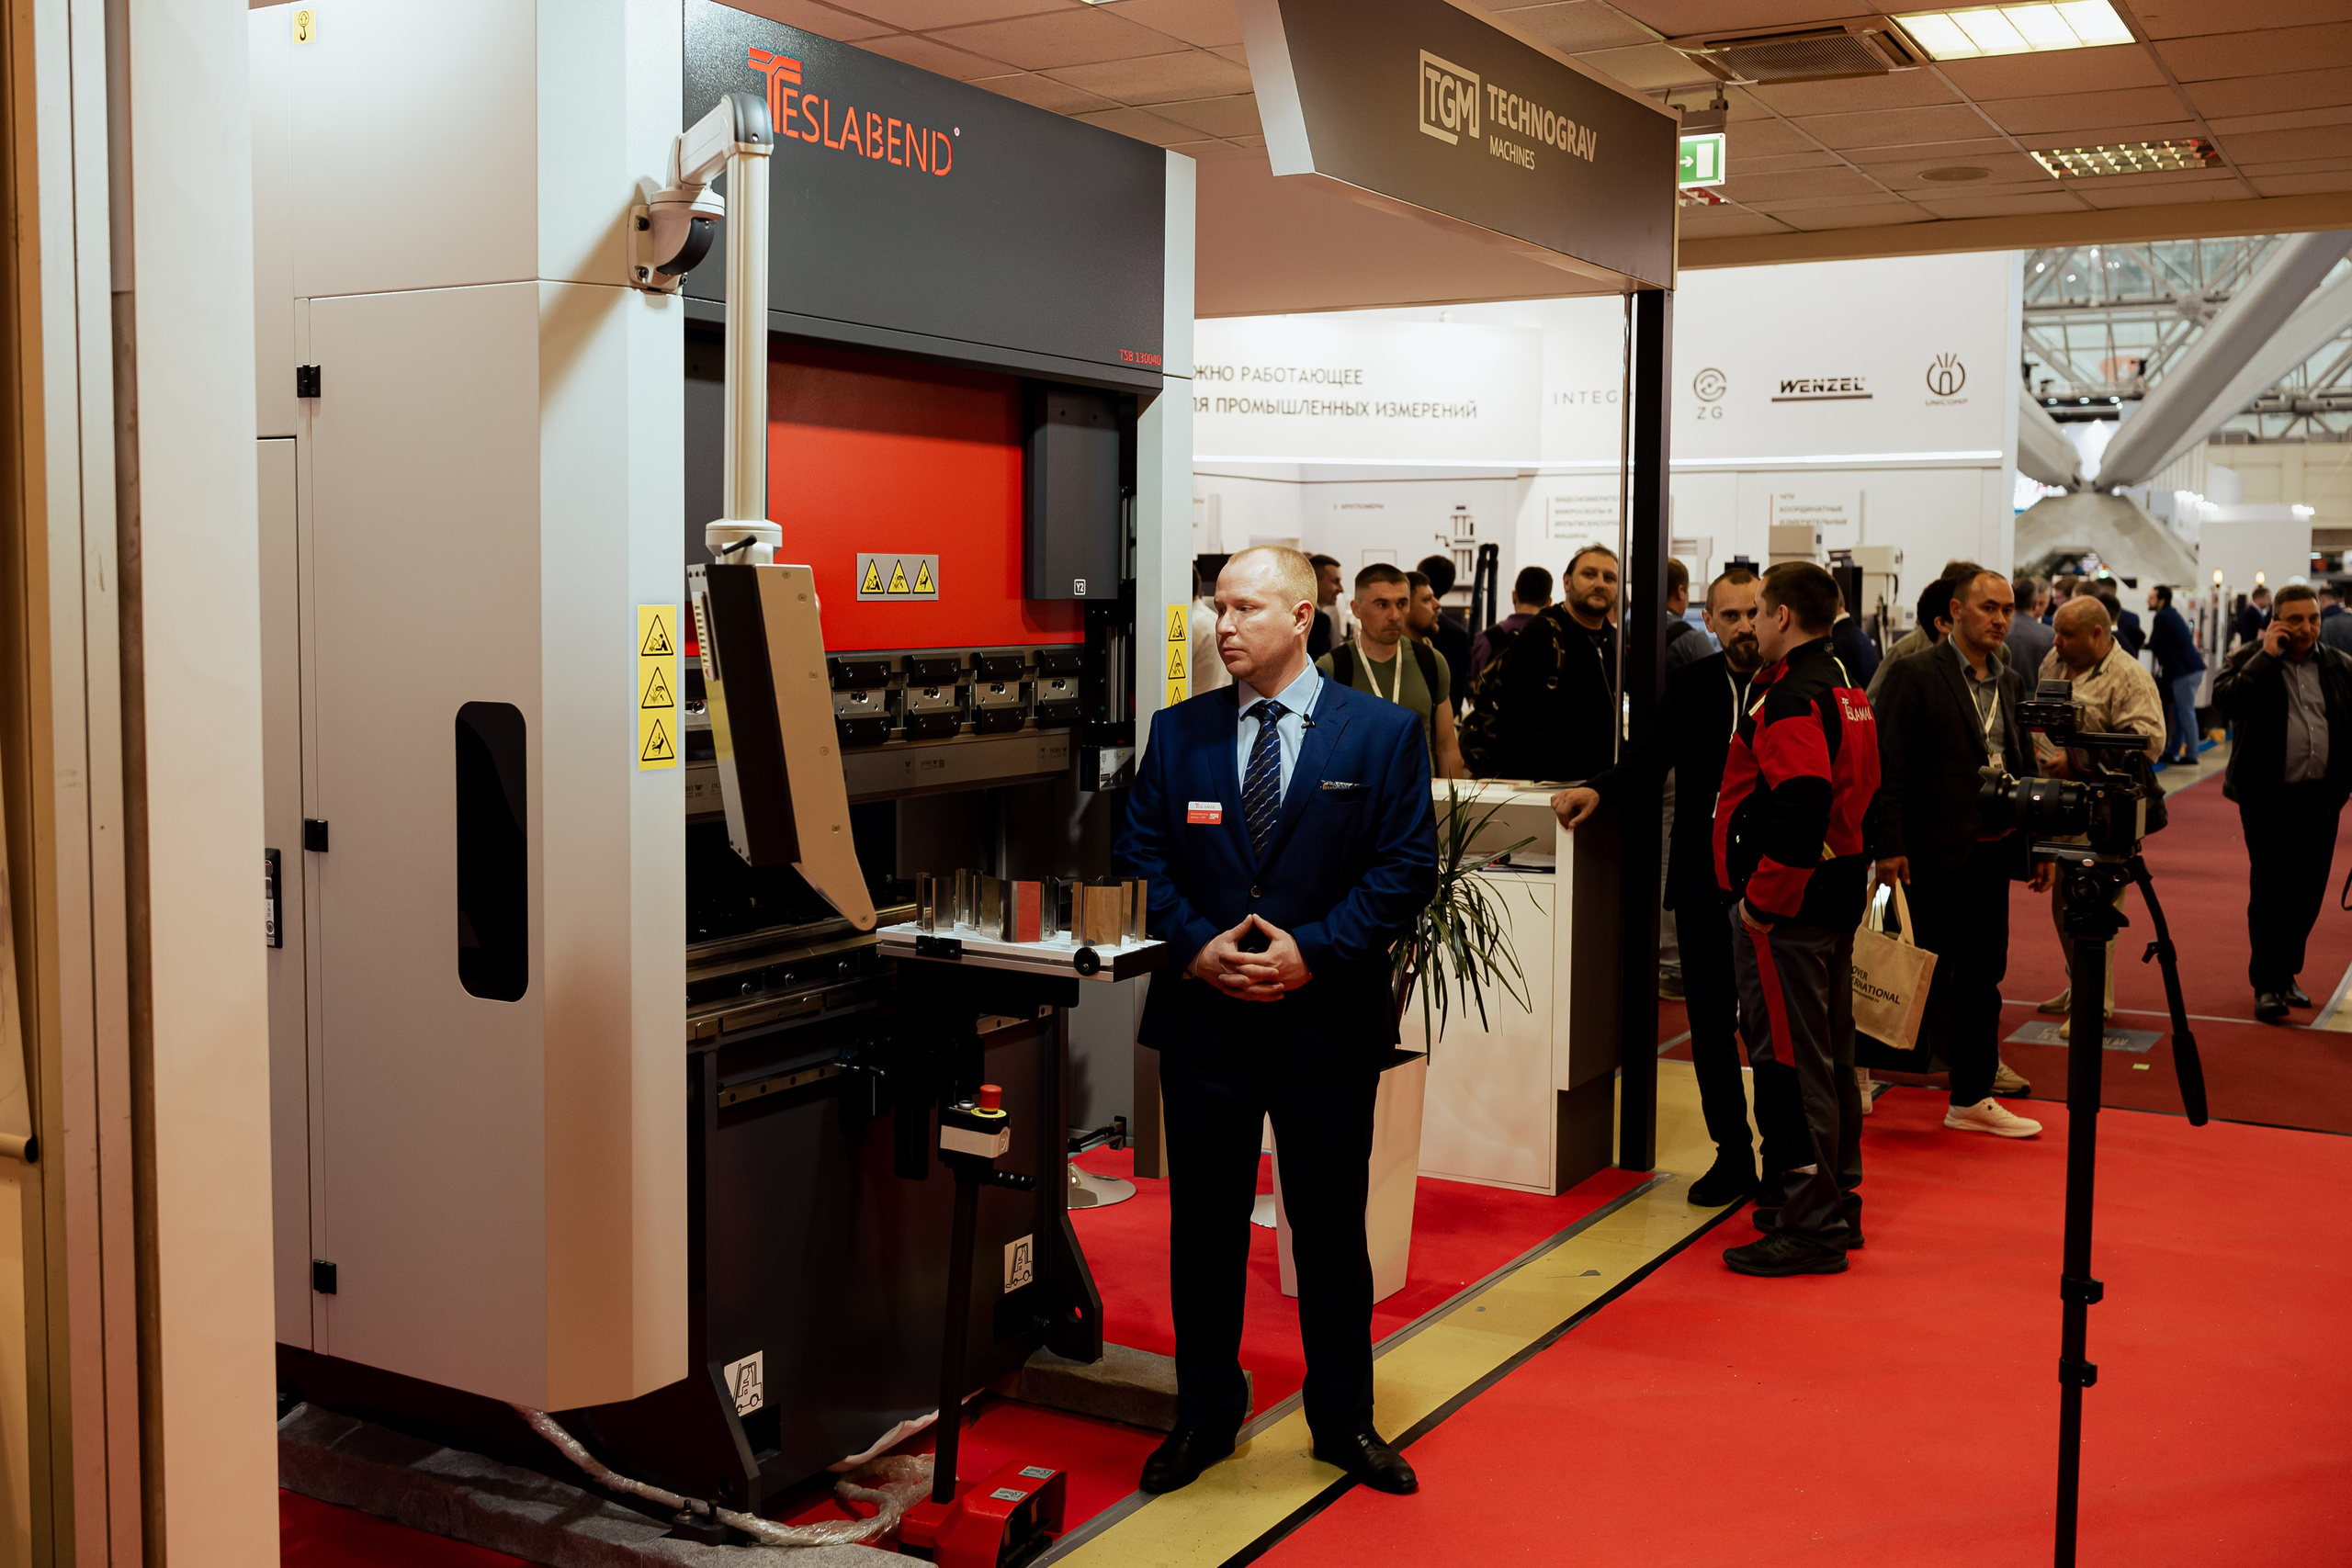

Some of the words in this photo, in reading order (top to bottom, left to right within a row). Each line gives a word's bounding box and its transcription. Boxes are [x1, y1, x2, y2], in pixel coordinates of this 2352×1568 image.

[1425, 66, 1474, 131] TGM
[748, 47, 953, 176] TESLABEND
[1487, 83, 1597, 163] TECHNOGRAV
[1489, 135, 1535, 170] MACHINES
[1119, 348, 1134, 363] TSB
[1136, 352, 1161, 367] 130040
[1241, 366, 1363, 387] РАБОТАЮЩЕЕ
[1781, 378, 1864, 393] WENZEL
[1554, 389, 1634, 405] INTEG
[1216, 397, 1370, 416] ПРОМЫШЛЕННЫХ
[1376, 400, 1477, 419] ИЗМЕРЕНИЙ
[1076, 582, 1084, 592] Y2
